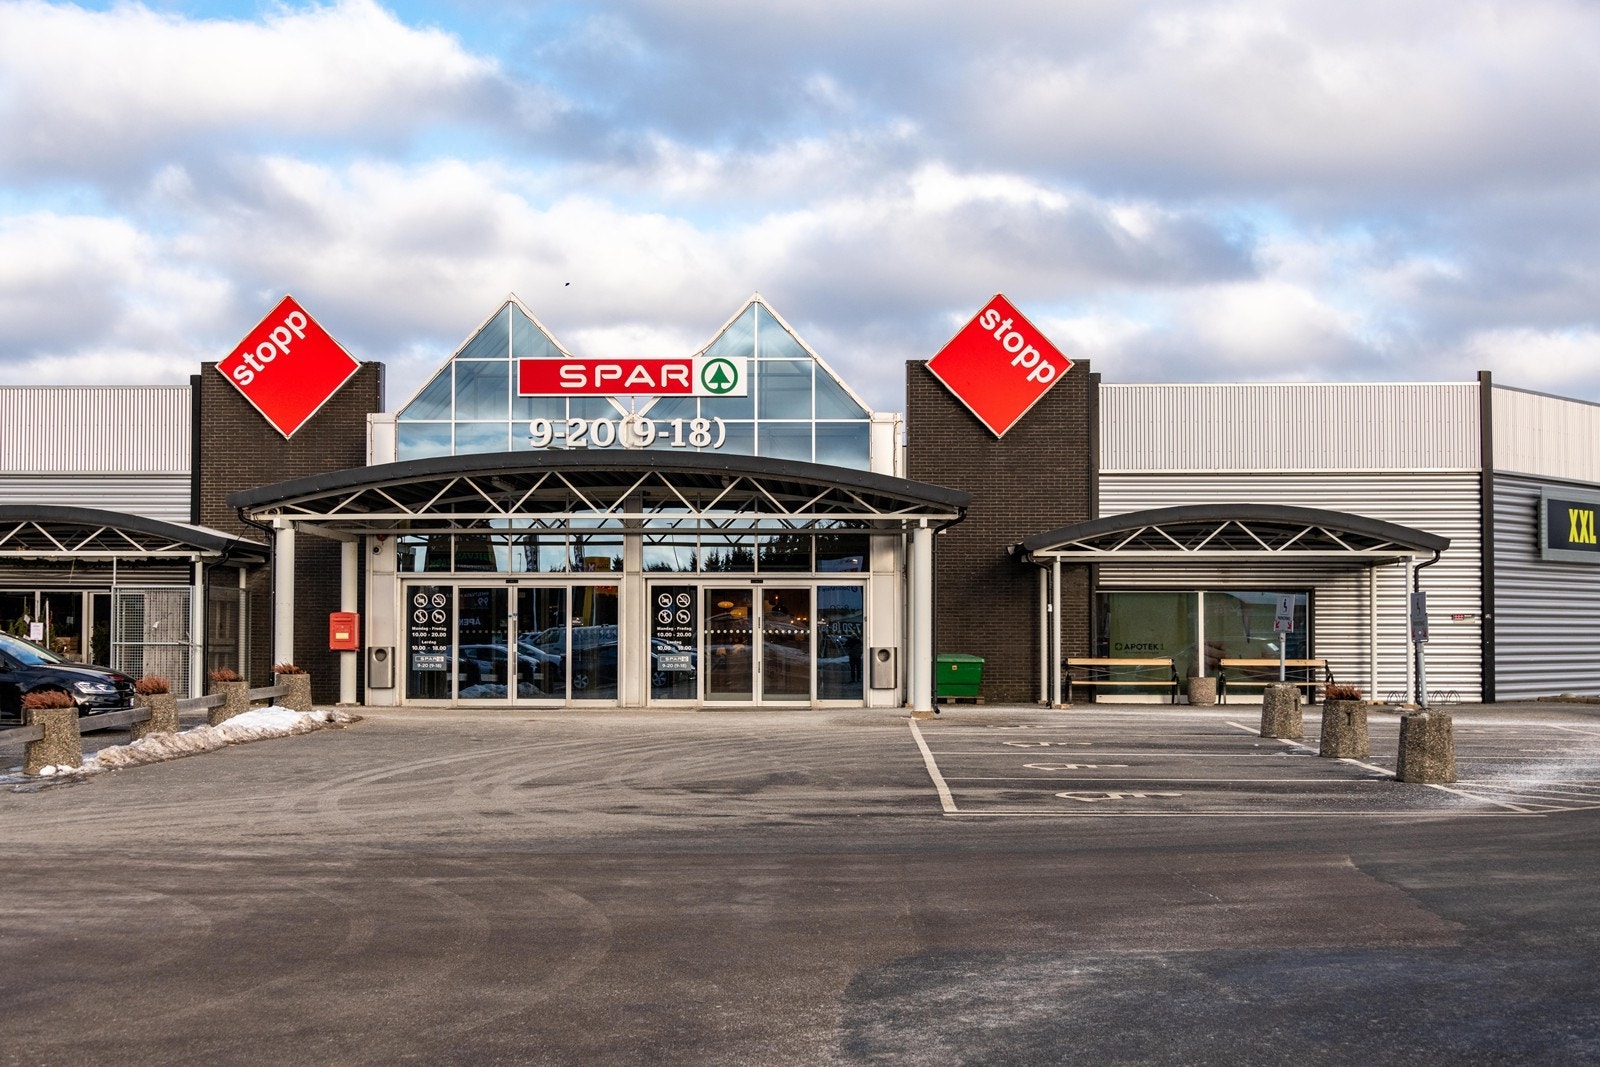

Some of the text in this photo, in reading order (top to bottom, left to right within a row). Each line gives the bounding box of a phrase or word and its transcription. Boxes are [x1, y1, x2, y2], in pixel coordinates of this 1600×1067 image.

[233, 310, 308, 386] stopp
[979, 308, 1056, 384] stopp
[559, 364, 689, 388] SPAR
[1568, 508, 1597, 544] XXL
